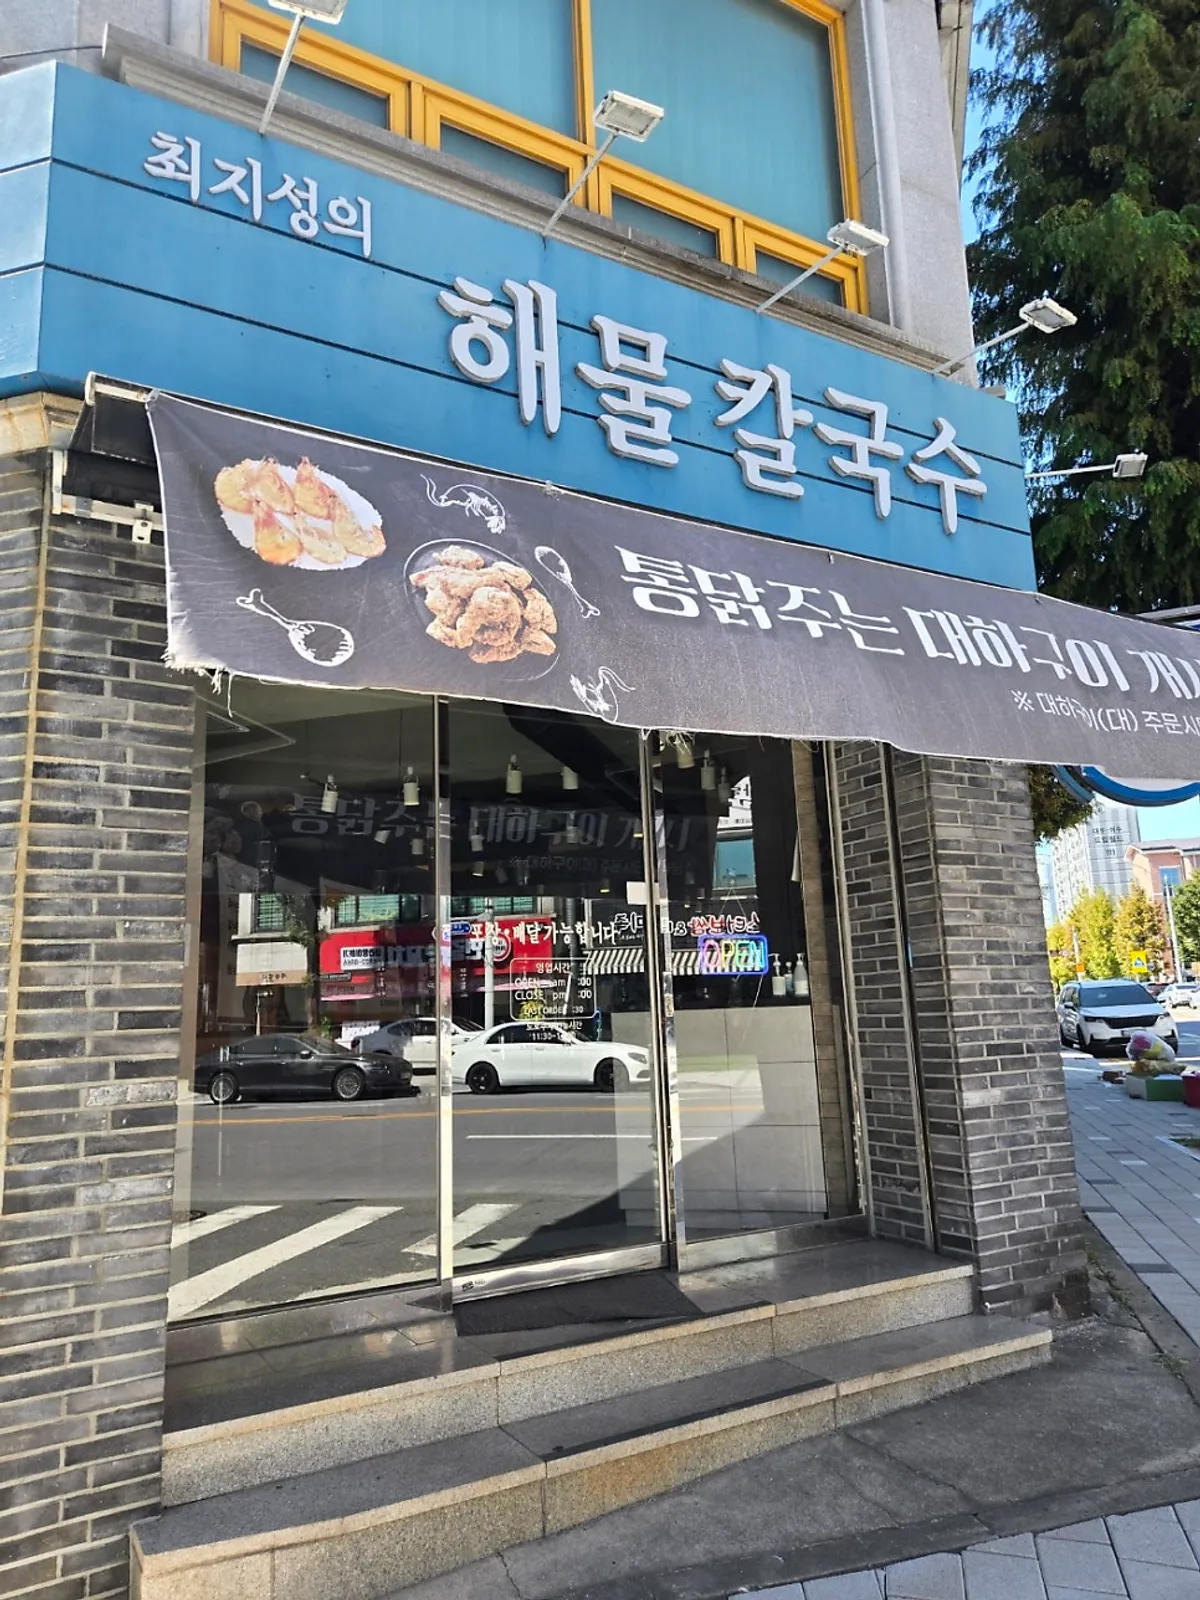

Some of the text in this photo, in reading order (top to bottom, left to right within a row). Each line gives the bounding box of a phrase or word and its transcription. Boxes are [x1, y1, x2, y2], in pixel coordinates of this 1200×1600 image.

[143, 131, 372, 259] 최지성의
[437, 275, 989, 536] 해물칼국수
[613, 544, 906, 656] 통닭주는
[901, 606, 1131, 692] 대하구이
[514, 990, 544, 1001] CLOSE
[703, 940, 765, 970] OPEN
